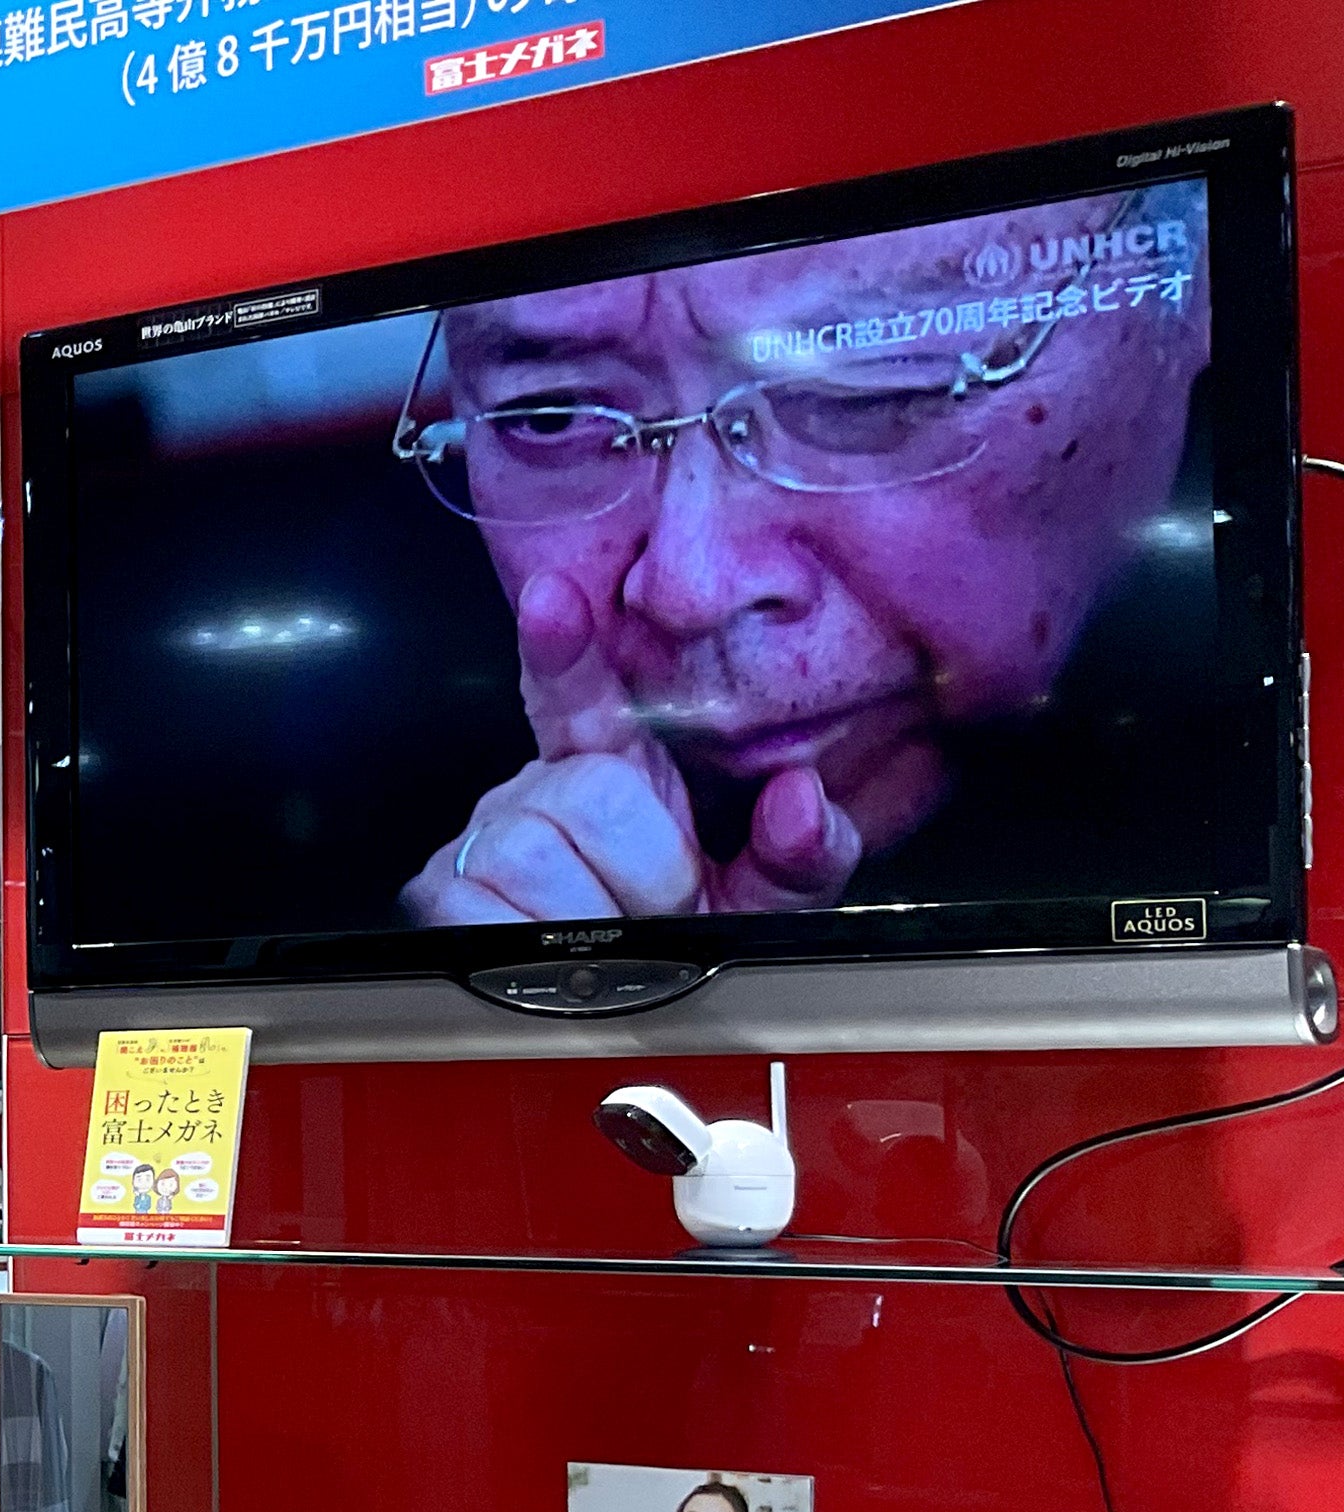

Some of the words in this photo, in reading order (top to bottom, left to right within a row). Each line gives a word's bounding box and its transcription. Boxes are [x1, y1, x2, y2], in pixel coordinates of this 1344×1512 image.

[431, 28, 600, 92] 富士メガネ
[1030, 219, 1187, 271] UNHCR
[51, 337, 104, 361] AQUOS
[1145, 907, 1176, 918] LED
[540, 929, 623, 946] SHARP
[1123, 918, 1195, 934] AQUOS
[104, 1088, 225, 1116] 困ったとき
[101, 1118, 223, 1146] 富士メガネ
